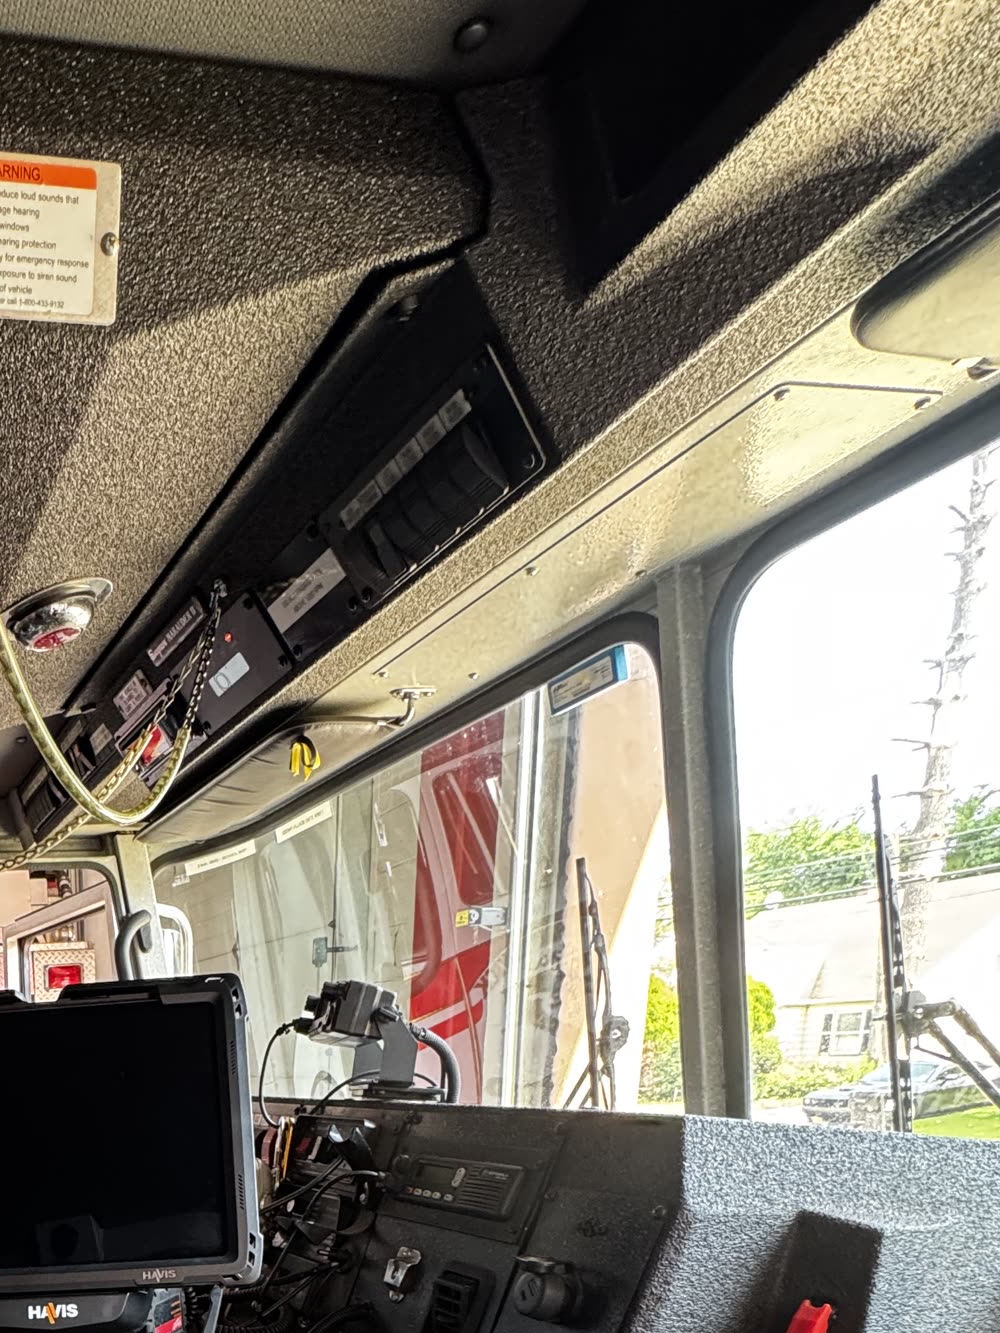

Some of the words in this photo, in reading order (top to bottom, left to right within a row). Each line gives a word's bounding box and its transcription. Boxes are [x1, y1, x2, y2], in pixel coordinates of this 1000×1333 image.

[21, 190, 36, 201] loud
[38, 192, 63, 204] sounds
[65, 195, 79, 205] that
[12, 206, 40, 219] hearing
[0, 221, 30, 232] windows
[21, 239, 57, 250] protection
[5, 252, 15, 262] for
[16, 255, 56, 268] emergency
[57, 258, 90, 269] response
[28, 269, 36, 280] to
[37, 271, 54, 281] siren
[56, 273, 78, 283] sound
[0, 283, 7, 293] of
[8, 283, 33, 295] vehicle
[6, 297, 17, 305] call
[142, 1268, 176, 1283] HAVIS
[27, 1302, 79, 1325] HAVIS
